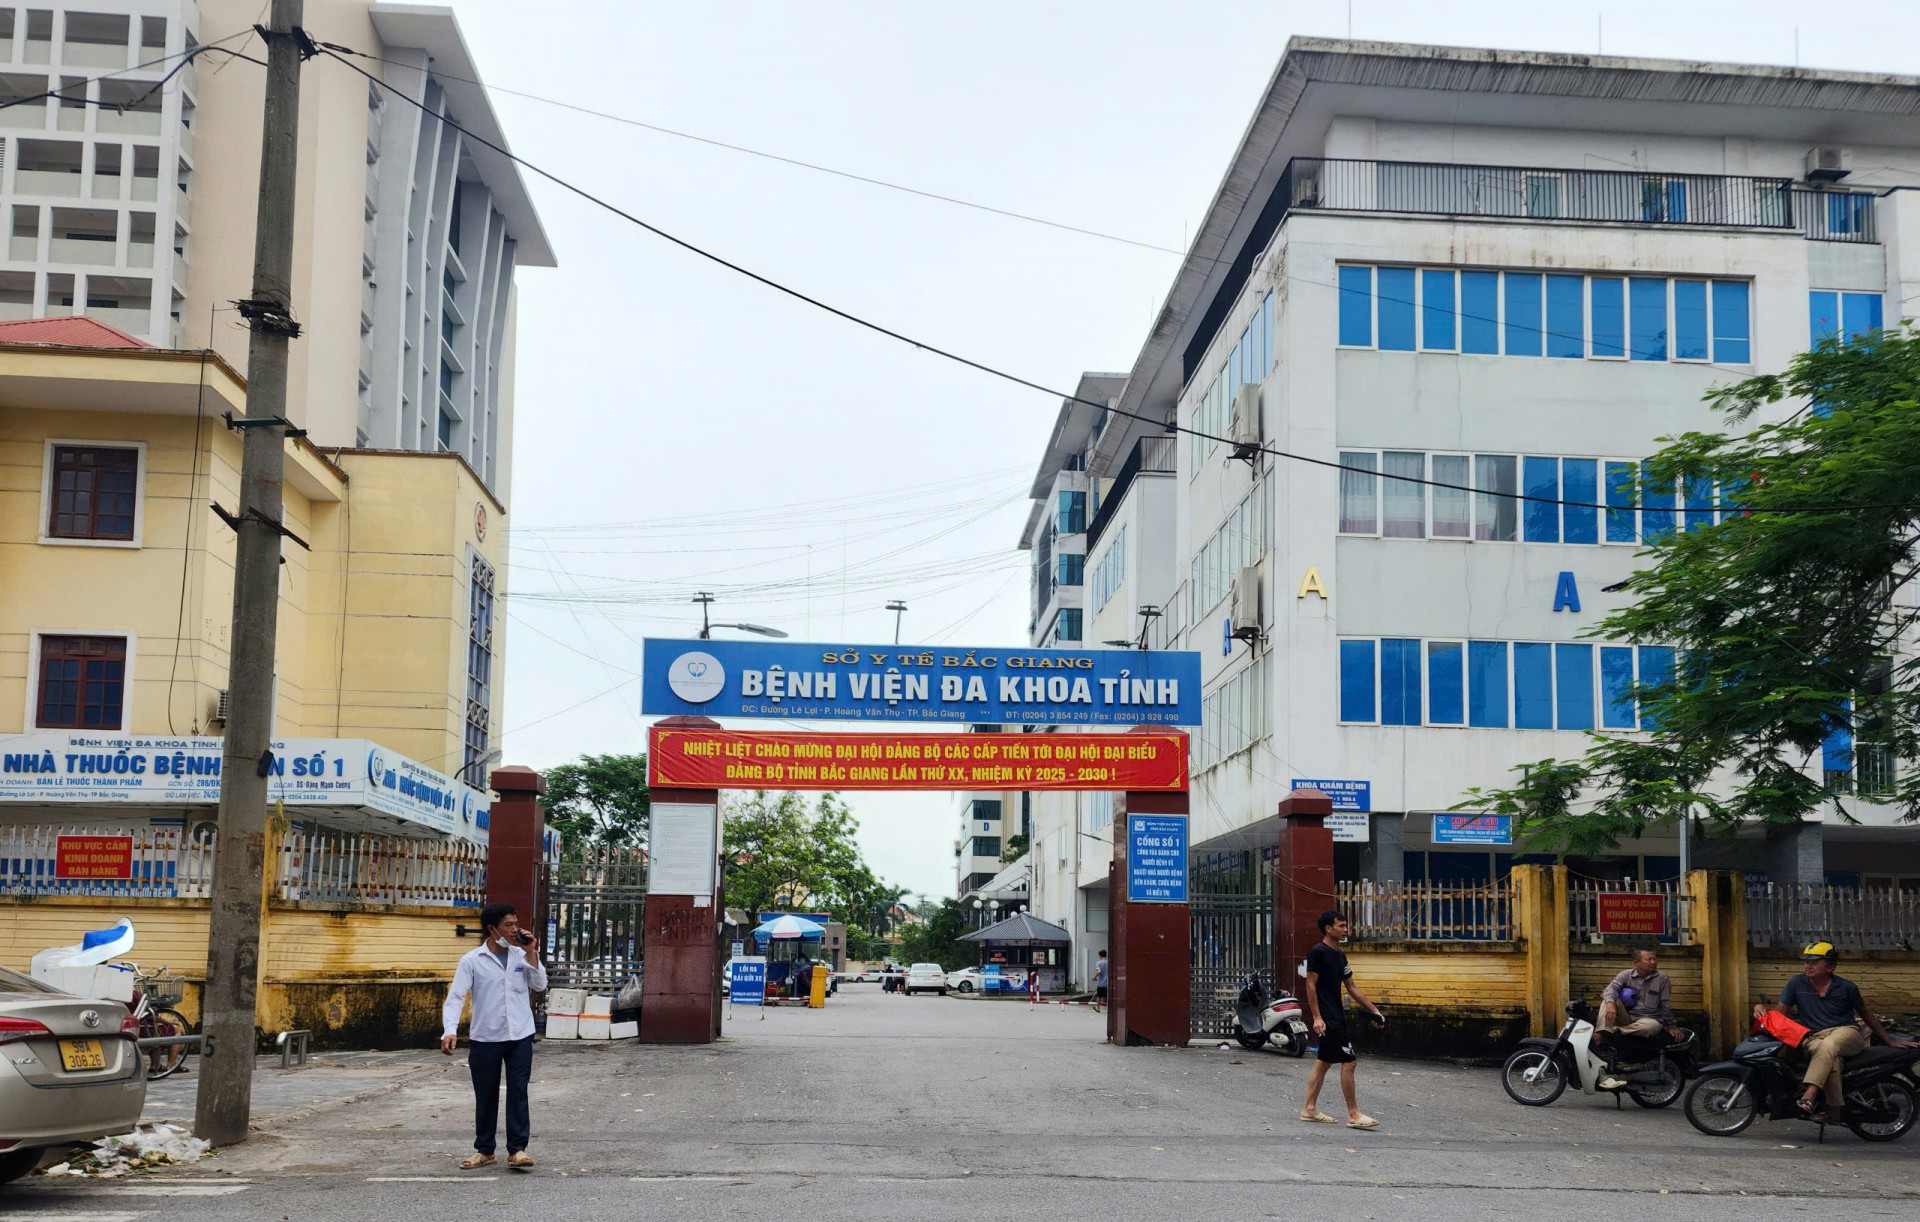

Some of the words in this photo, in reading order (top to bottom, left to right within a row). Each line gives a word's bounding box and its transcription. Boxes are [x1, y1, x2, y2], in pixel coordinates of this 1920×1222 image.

[1297, 566, 1328, 599] A
[1553, 571, 1581, 612] A
[822, 648, 860, 665] SỞ
[869, 654, 889, 665] Y
[897, 651, 935, 666] TẾ
[942, 650, 998, 668] BẮC
[1006, 657, 1095, 669] GIANG
[742, 664, 837, 703] BỆNH
[848, 667, 929, 706] VIỆN
[941, 675, 988, 702] ĐA
[1000, 676, 1092, 703] KHOA
[1100, 669, 1178, 705] TỈNH
[742, 705, 758, 713] ĐC:
[761, 705, 788, 715] Đường
[791, 706, 802, 714] Lê
[804, 706, 818, 715] Lợi
[834, 707, 862, 717] Hoàng
[865, 708, 882, 716] Văn
[884, 709, 900, 717] Thụ
[907, 709, 920, 717] TP.
[922, 709, 938, 717] Bắc
[941, 709, 965, 719] Giang
[1006, 711, 1020, 719] ĐT:
[1022, 711, 1048, 720] (0204)
[1074, 712, 1088, 720] 249
[1094, 712, 1112, 720] Fax:
[1114, 713, 1139, 721] (0204)
[1164, 713, 1178, 721] 490
[155, 740, 188, 748] KHOA
[684, 739, 722, 759] NHIỆT
[725, 740, 752, 759] LIỆT
[755, 741, 790, 757] CHÀO
[793, 742, 832, 758] MỪNG
[835, 745, 858, 761] ĐẠI
[861, 742, 882, 761] HỘI
[886, 741, 920, 759] ĐẢNG
[924, 743, 941, 761] BỘ
[944, 743, 970, 759] CÁC
[973, 741, 998, 759] CẤP
[1002, 742, 1030, 759] TIẾN
[1033, 743, 1052, 760] TỚI
[1055, 746, 1076, 762] ĐẠI
[1080, 743, 1101, 762] HỘI
[1104, 746, 1125, 762] ĐẠI
[1128, 741, 1157, 760] BIỂU
[3, 749, 57, 773] NHÀ
[65, 747, 147, 774] THUỐC
[154, 751, 221, 779] BỆNH
[292, 750, 326, 777] SỐ
[333, 758, 344, 777] 1
[726, 760, 763, 779] ĐẢNG
[766, 763, 784, 782] BỘ
[787, 762, 817, 780] TỈNH
[820, 762, 846, 780] BẮC
[849, 767, 889, 780] GIANG
[921, 765, 946, 780] THỨ
[948, 767, 969, 782] XX,
[972, 765, 1013, 783] NHIỆM
[1016, 765, 1032, 780] KỲ
[1036, 767, 1066, 781] 2025
[1078, 767, 1108, 781] 2030
[1296, 781, 1318, 789] KHOA
[1319, 781, 1344, 790] KHÁM
[1345, 781, 1367, 791] BỆNH
[983, 822, 990, 831] D
[62, 842, 82, 850] KHU
[85, 842, 103, 851] VỰC
[106, 841, 128, 850] CẤM
[1162, 835, 1174, 847] SỐ
[1175, 838, 1180, 847] 1
[65, 854, 88, 863] KINH
[91, 855, 124, 863] DOANH
[1603, 899, 1621, 907] KHU
[1607, 911, 1627, 919] KINH
[1629, 911, 1657, 919] DOANH
[71, 1040, 91, 1053] 98A
[204, 1035, 217, 1058] 5
[68, 1054, 102, 1068] 308.26
